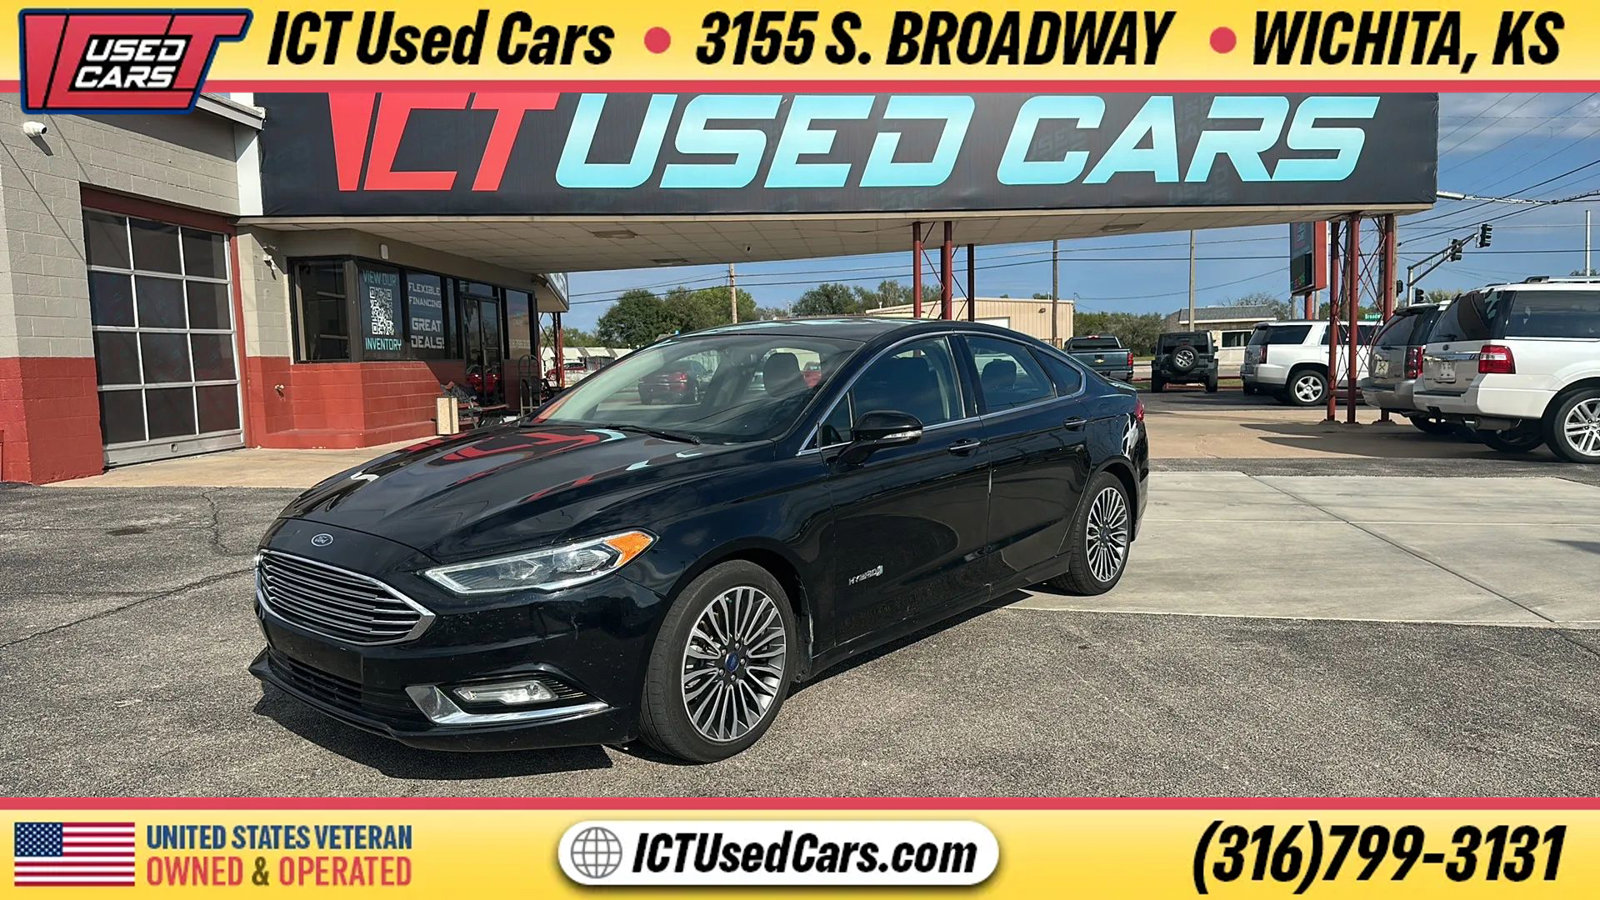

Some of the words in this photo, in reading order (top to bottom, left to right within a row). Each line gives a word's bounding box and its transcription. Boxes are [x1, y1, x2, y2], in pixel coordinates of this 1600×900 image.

[329, 94, 560, 191] ICT
[556, 93, 975, 189] USED
[997, 95, 1381, 185] CARS
[362, 269, 380, 285] VIEW
[408, 281, 441, 296] FLEXIBLE
[408, 296, 442, 309] FINANCING
[411, 317, 442, 333] GREAT
[365, 337, 402, 351] INVENTORY
[410, 335, 445, 350] DEALS!
